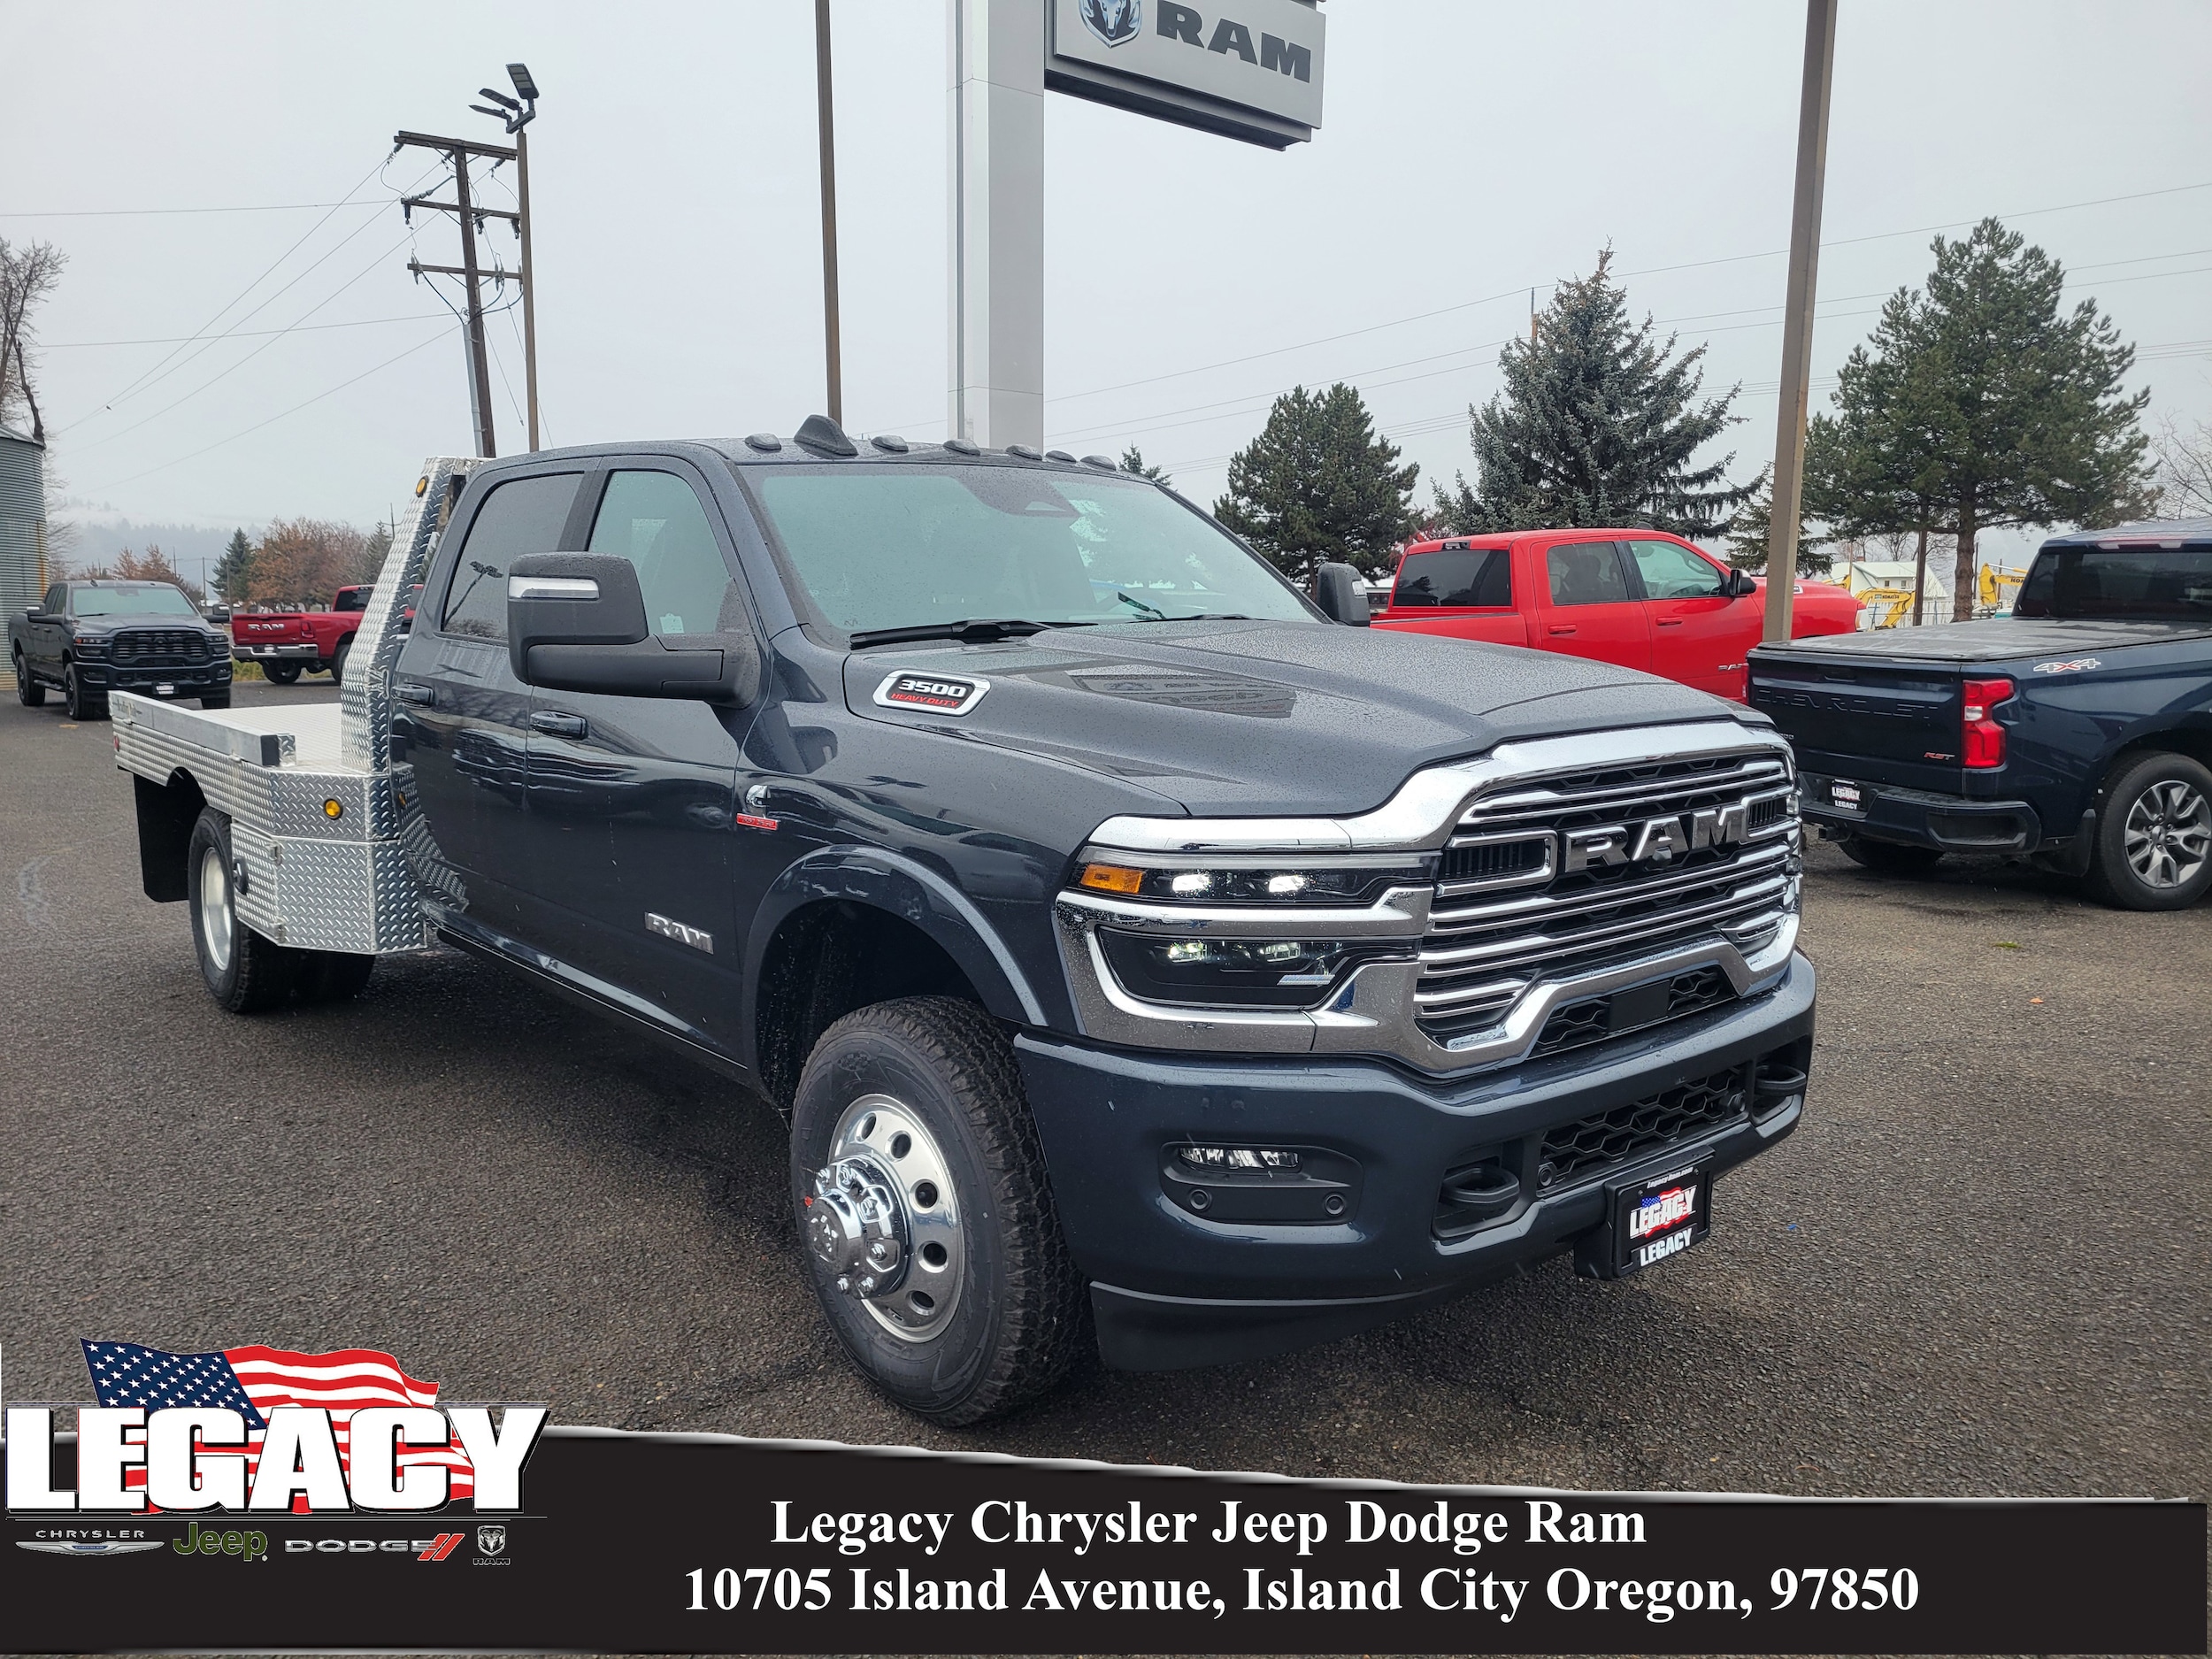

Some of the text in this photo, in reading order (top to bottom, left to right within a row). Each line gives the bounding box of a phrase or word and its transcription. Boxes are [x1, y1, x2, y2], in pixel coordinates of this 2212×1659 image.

[1156, 1, 1311, 83] RAM
[890, 693, 960, 707] HEAVY DUTY
[898, 679, 968, 698] 3500
[1832, 787, 1860, 800] LEGACY
[1834, 800, 1857, 810] LEGACY
[1564, 804, 1747, 873] RAM
[645, 912, 714, 955] RAM
[1630, 1187, 1697, 1237] LEGACY
[1640, 1228, 1693, 1266] LEGACY
